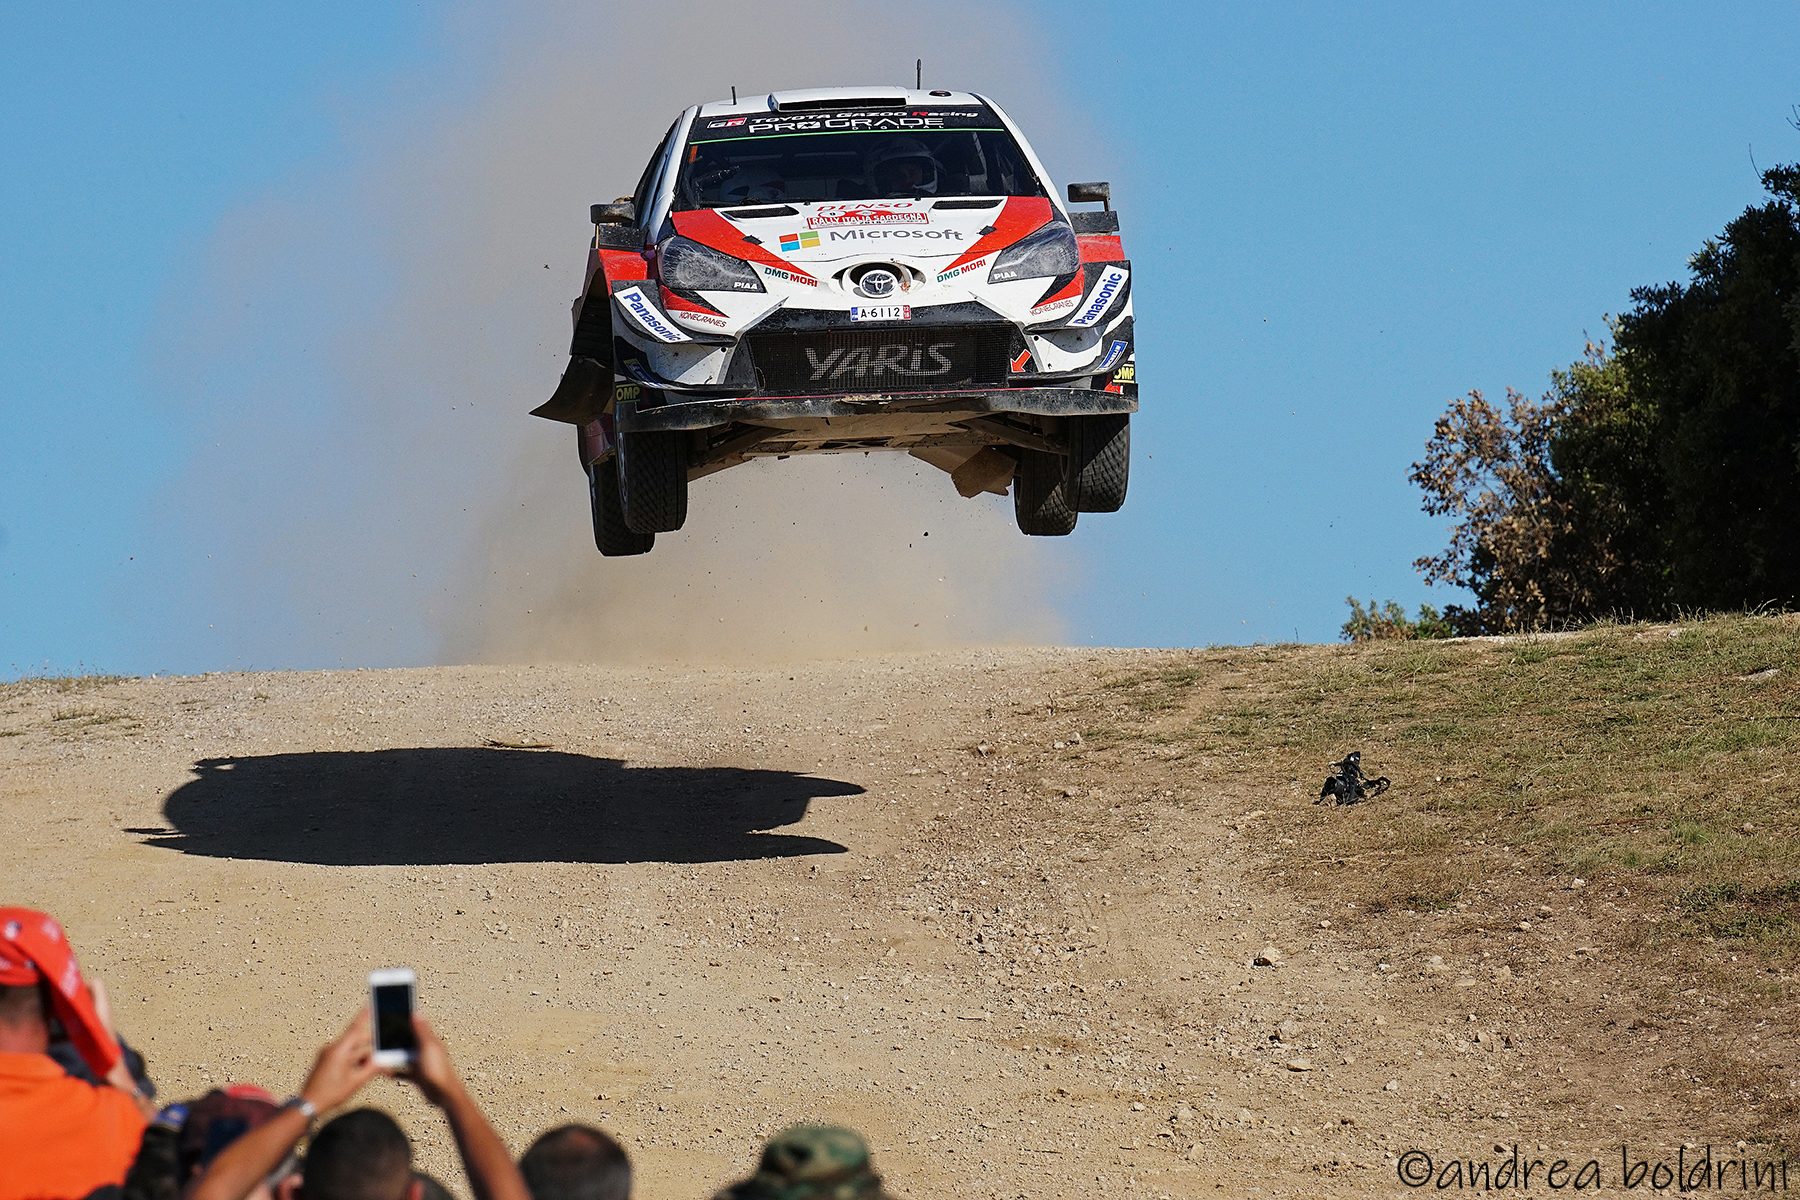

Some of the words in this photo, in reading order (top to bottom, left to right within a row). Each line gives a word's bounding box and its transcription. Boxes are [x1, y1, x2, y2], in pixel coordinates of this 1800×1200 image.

[708, 118, 747, 128] GR
[817, 203, 913, 211] DENSO
[812, 217, 841, 225] RALLY
[842, 215, 872, 223] ITALIA
[873, 212, 924, 222] SARDEGNA
[829, 229, 964, 241] Microsoft
[764, 267, 789, 280] DMG
[789, 274, 818, 288] MORI
[936, 269, 961, 283] DMG
[960, 259, 987, 274] MORI
[993, 270, 1018, 280] PIAA
[733, 281, 758, 290] PIAA
[1072, 272, 1123, 325] Panasonic
[1029, 300, 1074, 317] KONECRANES
[623, 292, 681, 341] Panasonic
[679, 311, 727, 328] KONECRANES
[1112, 367, 1135, 380] OMP
[615, 386, 640, 401] OMP
